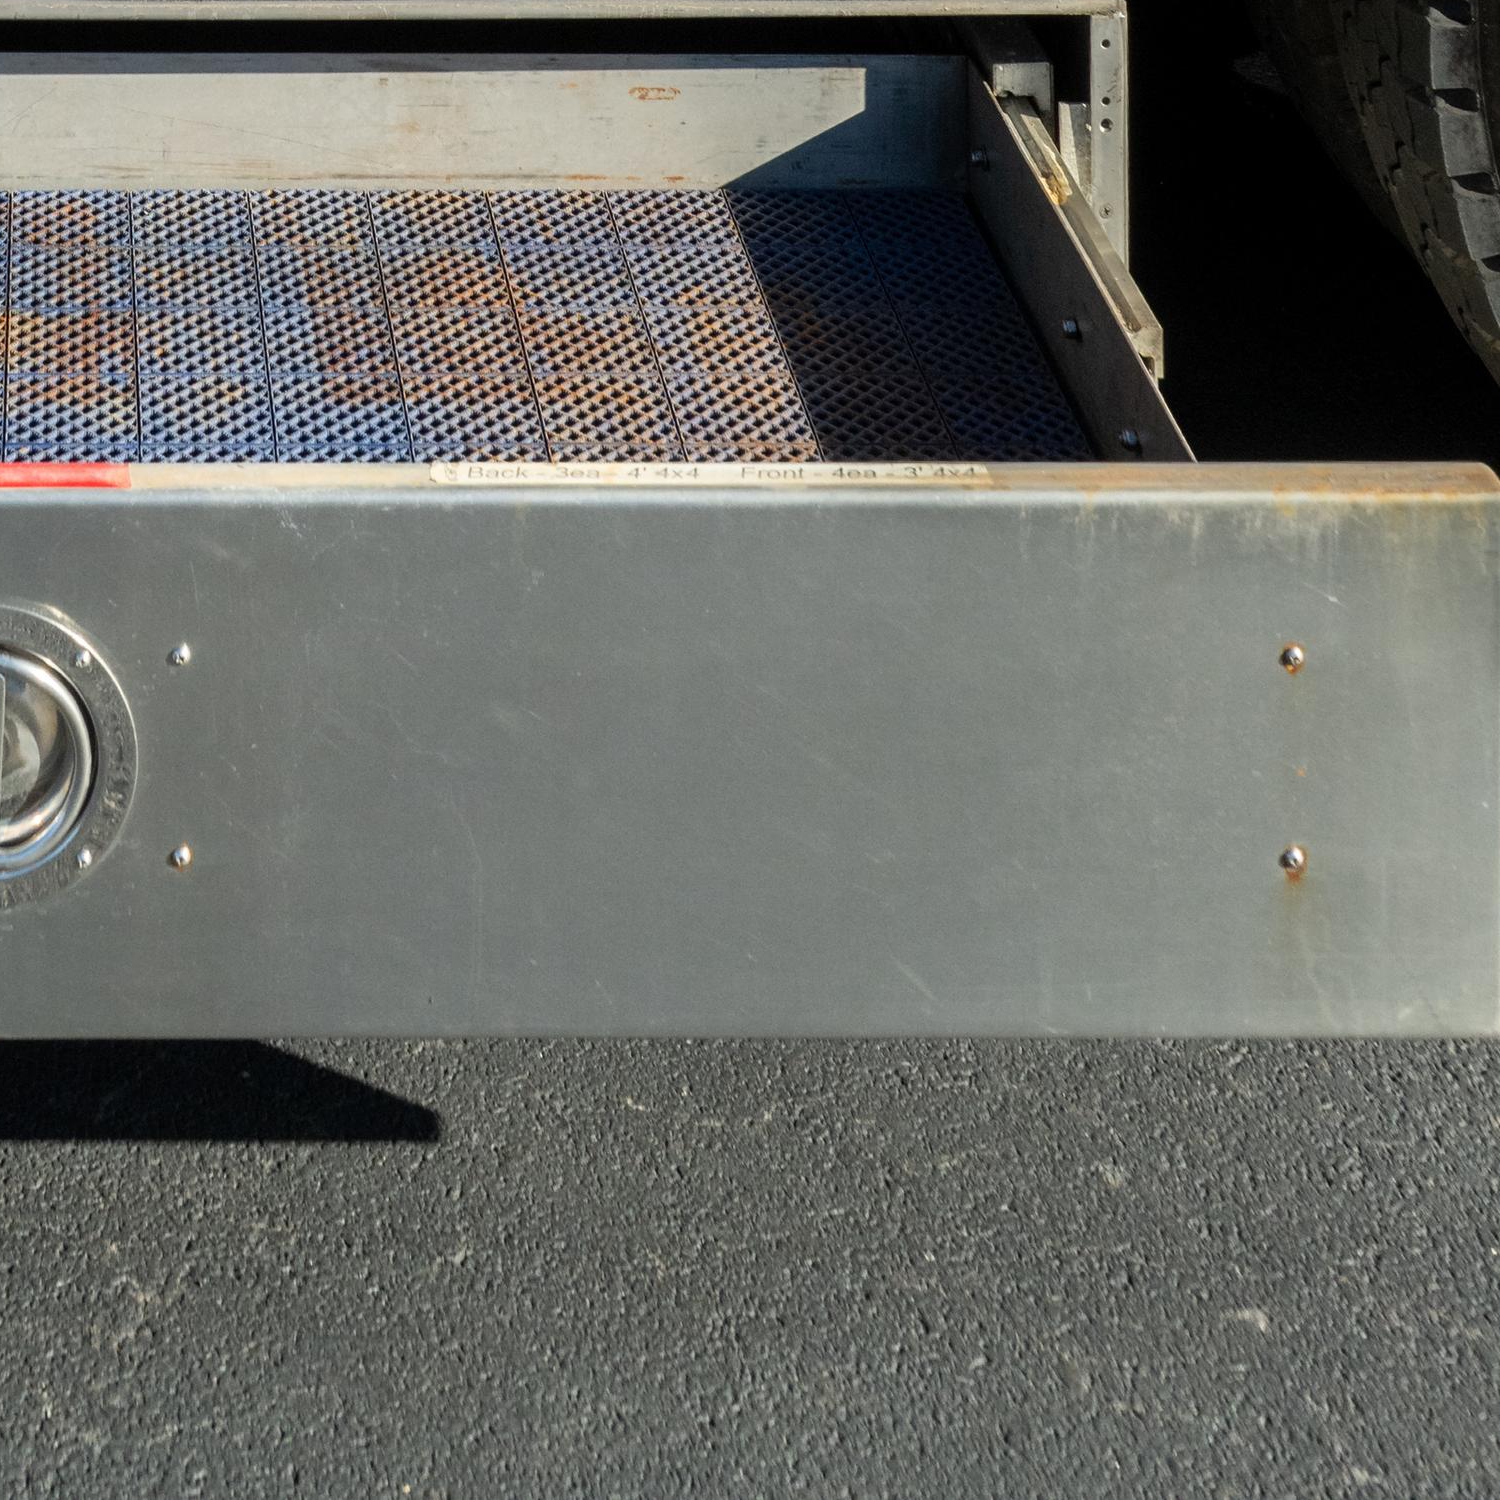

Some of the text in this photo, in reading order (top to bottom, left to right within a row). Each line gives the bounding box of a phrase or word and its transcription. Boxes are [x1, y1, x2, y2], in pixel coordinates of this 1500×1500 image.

[468, 466, 528, 479] Back
[656, 467, 700, 479] 4x4
[740, 466, 805, 480] Front
[932, 466, 976, 479] 4x4
